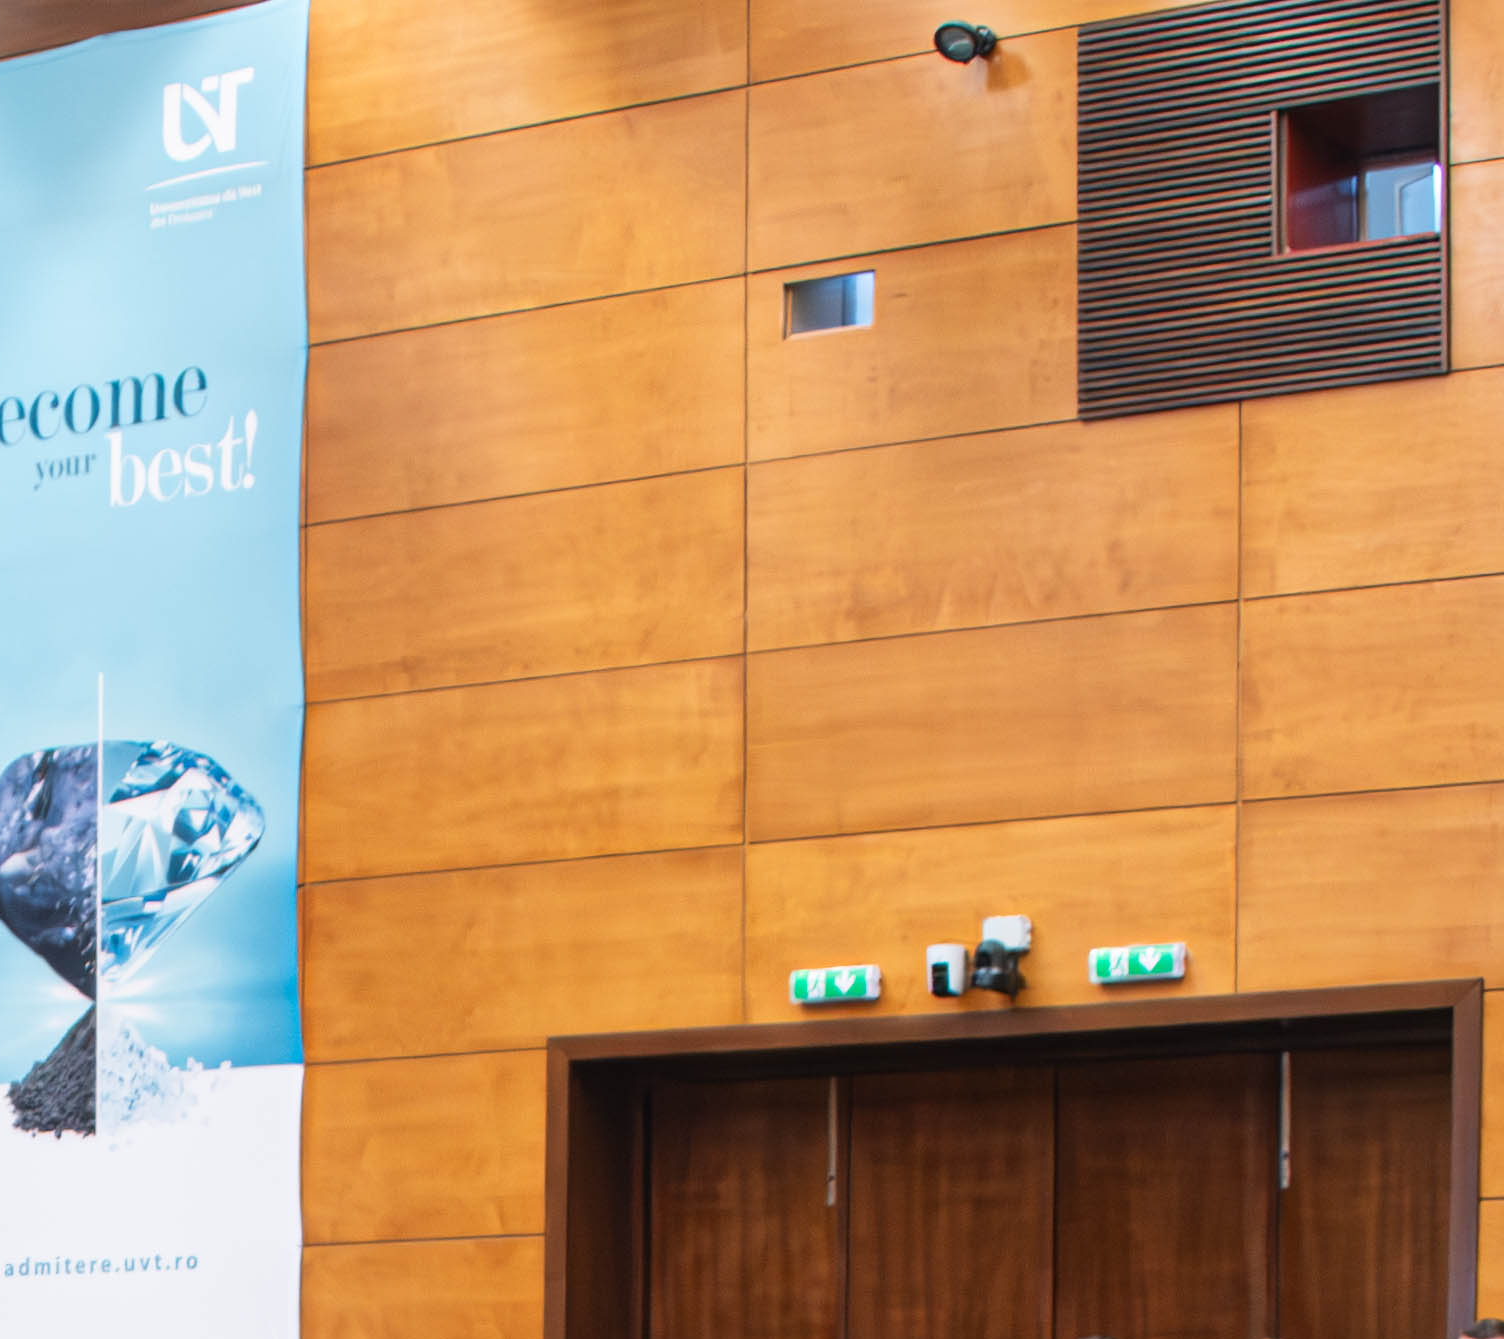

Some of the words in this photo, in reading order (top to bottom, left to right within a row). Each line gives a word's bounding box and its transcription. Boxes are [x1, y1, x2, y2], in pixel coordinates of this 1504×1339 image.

[32, 452, 97, 490] your
[104, 409, 260, 508] best!
[3, 1252, 200, 1279] admitere.uvt.ro
